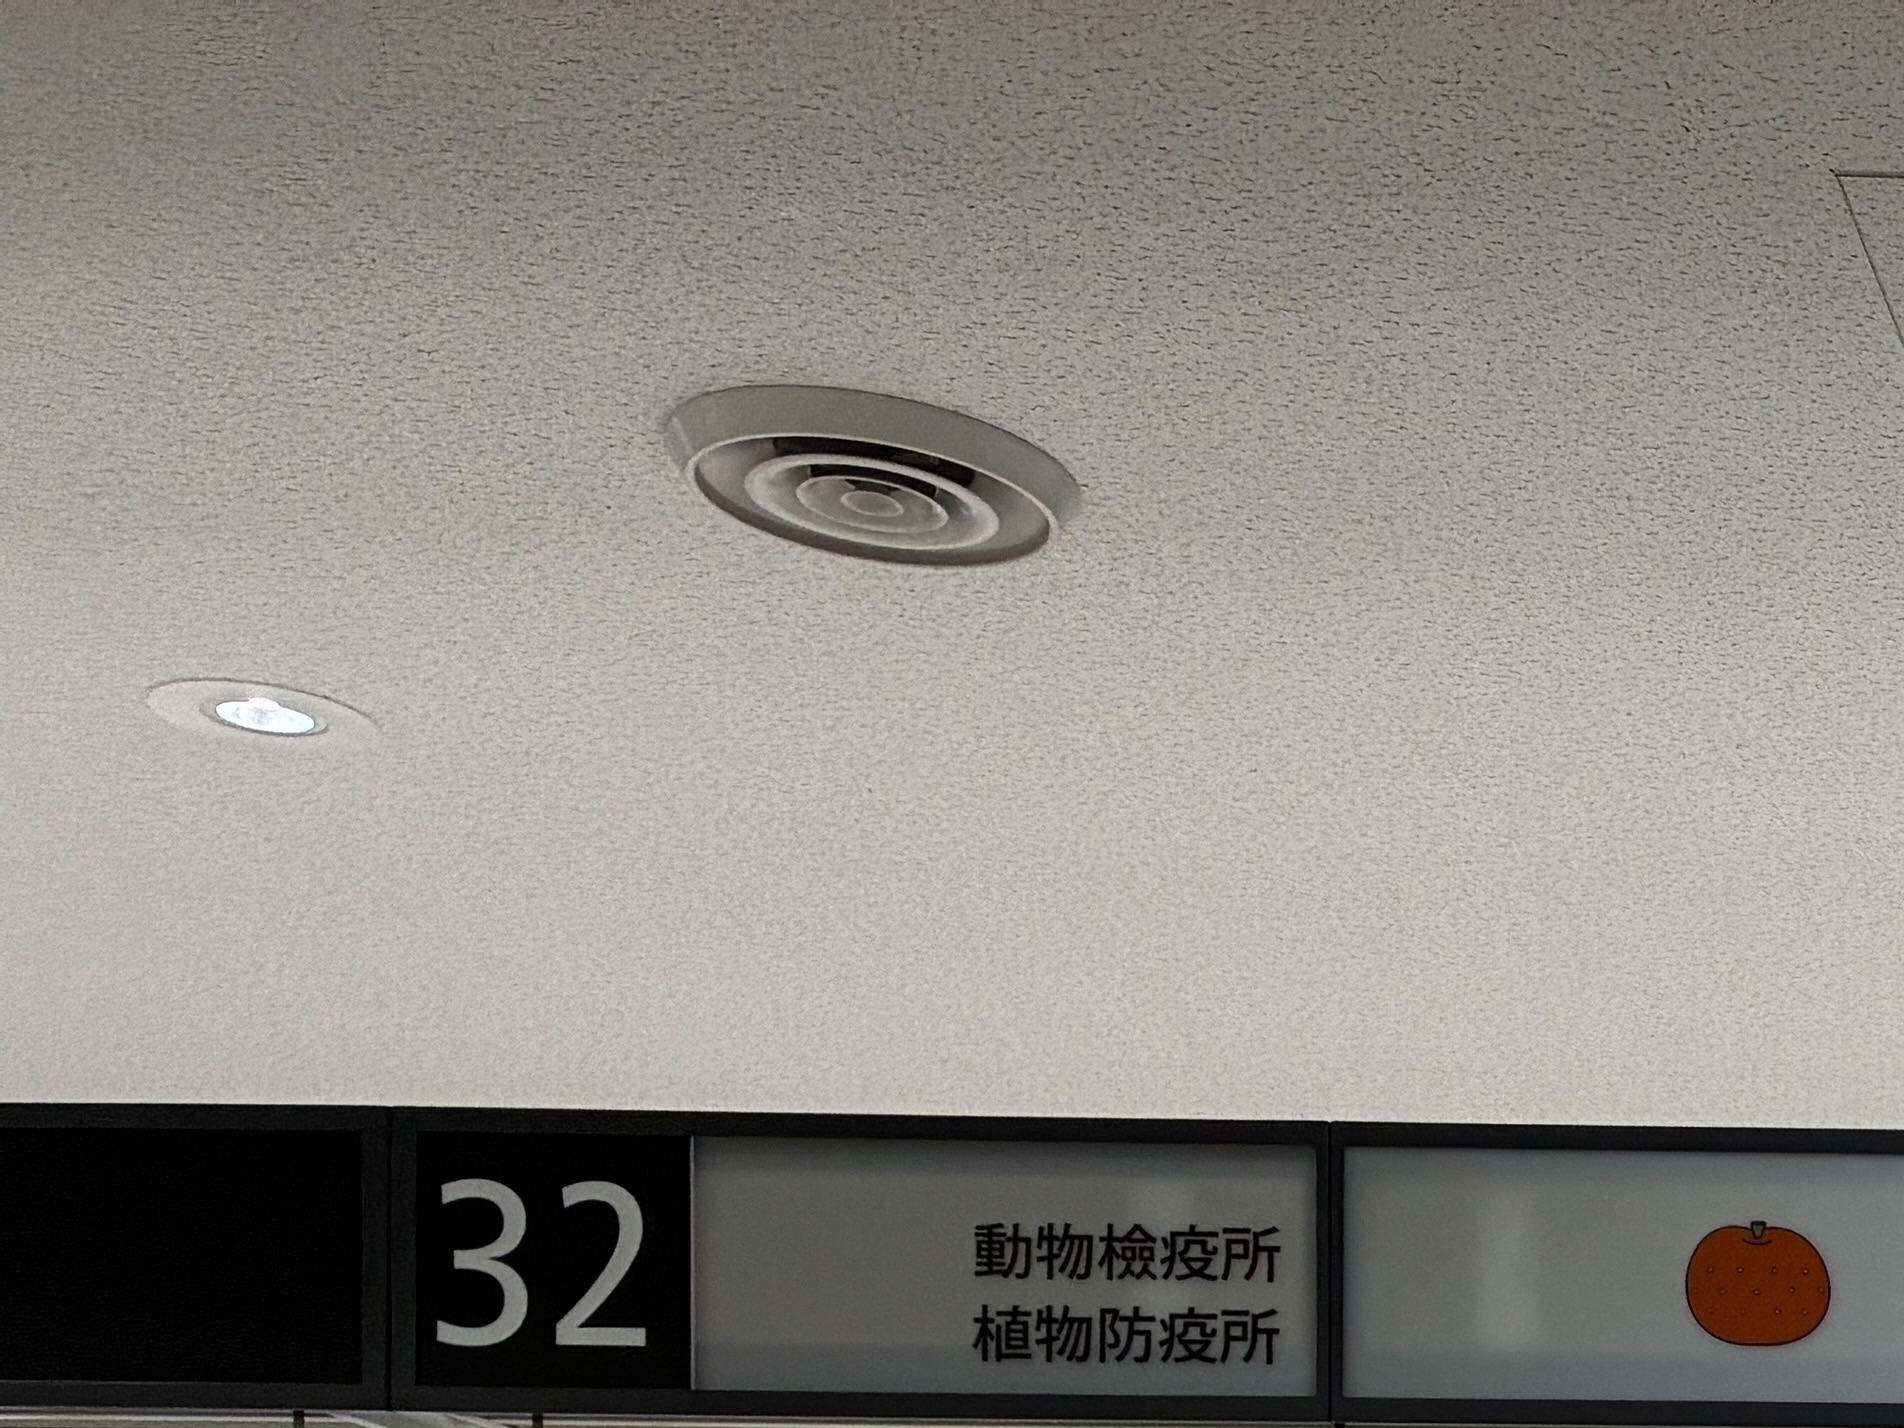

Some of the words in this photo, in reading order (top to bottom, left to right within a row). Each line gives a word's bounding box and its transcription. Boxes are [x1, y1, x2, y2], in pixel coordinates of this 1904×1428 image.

[435, 1178, 648, 1348] 32
[973, 1304, 1280, 1365] 植物防疫所
